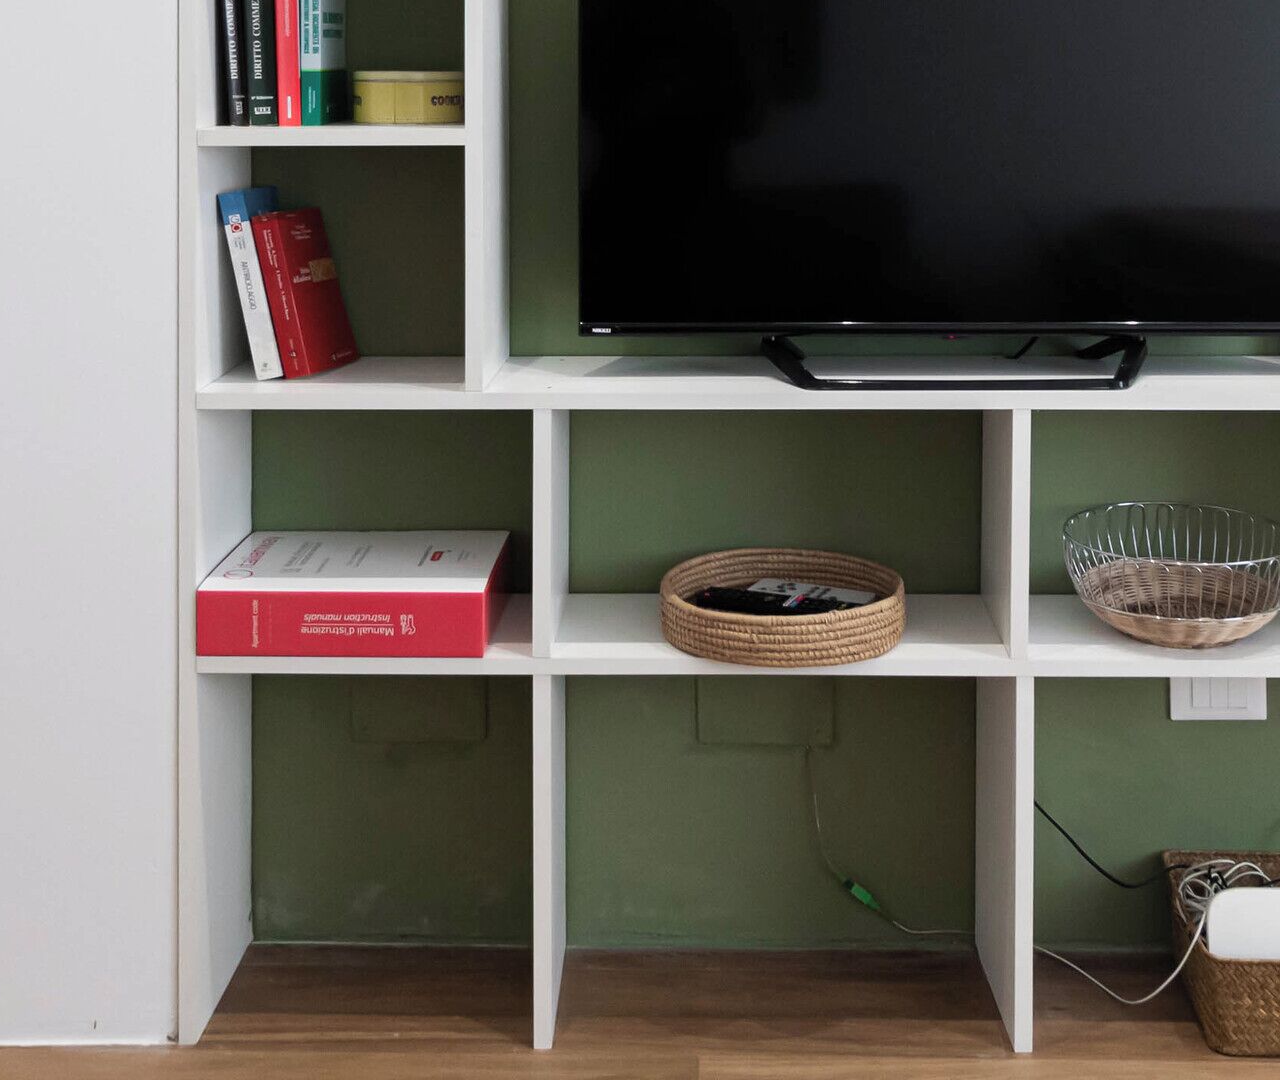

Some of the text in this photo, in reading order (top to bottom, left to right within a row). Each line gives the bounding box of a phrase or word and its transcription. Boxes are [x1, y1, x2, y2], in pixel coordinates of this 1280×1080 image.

[228, 40, 239, 80] DIRITTO
[254, 40, 262, 80] DIRITTO
[300, 626, 394, 636] Manuali d'istruzione
[304, 613, 390, 624] Instruction manuals
